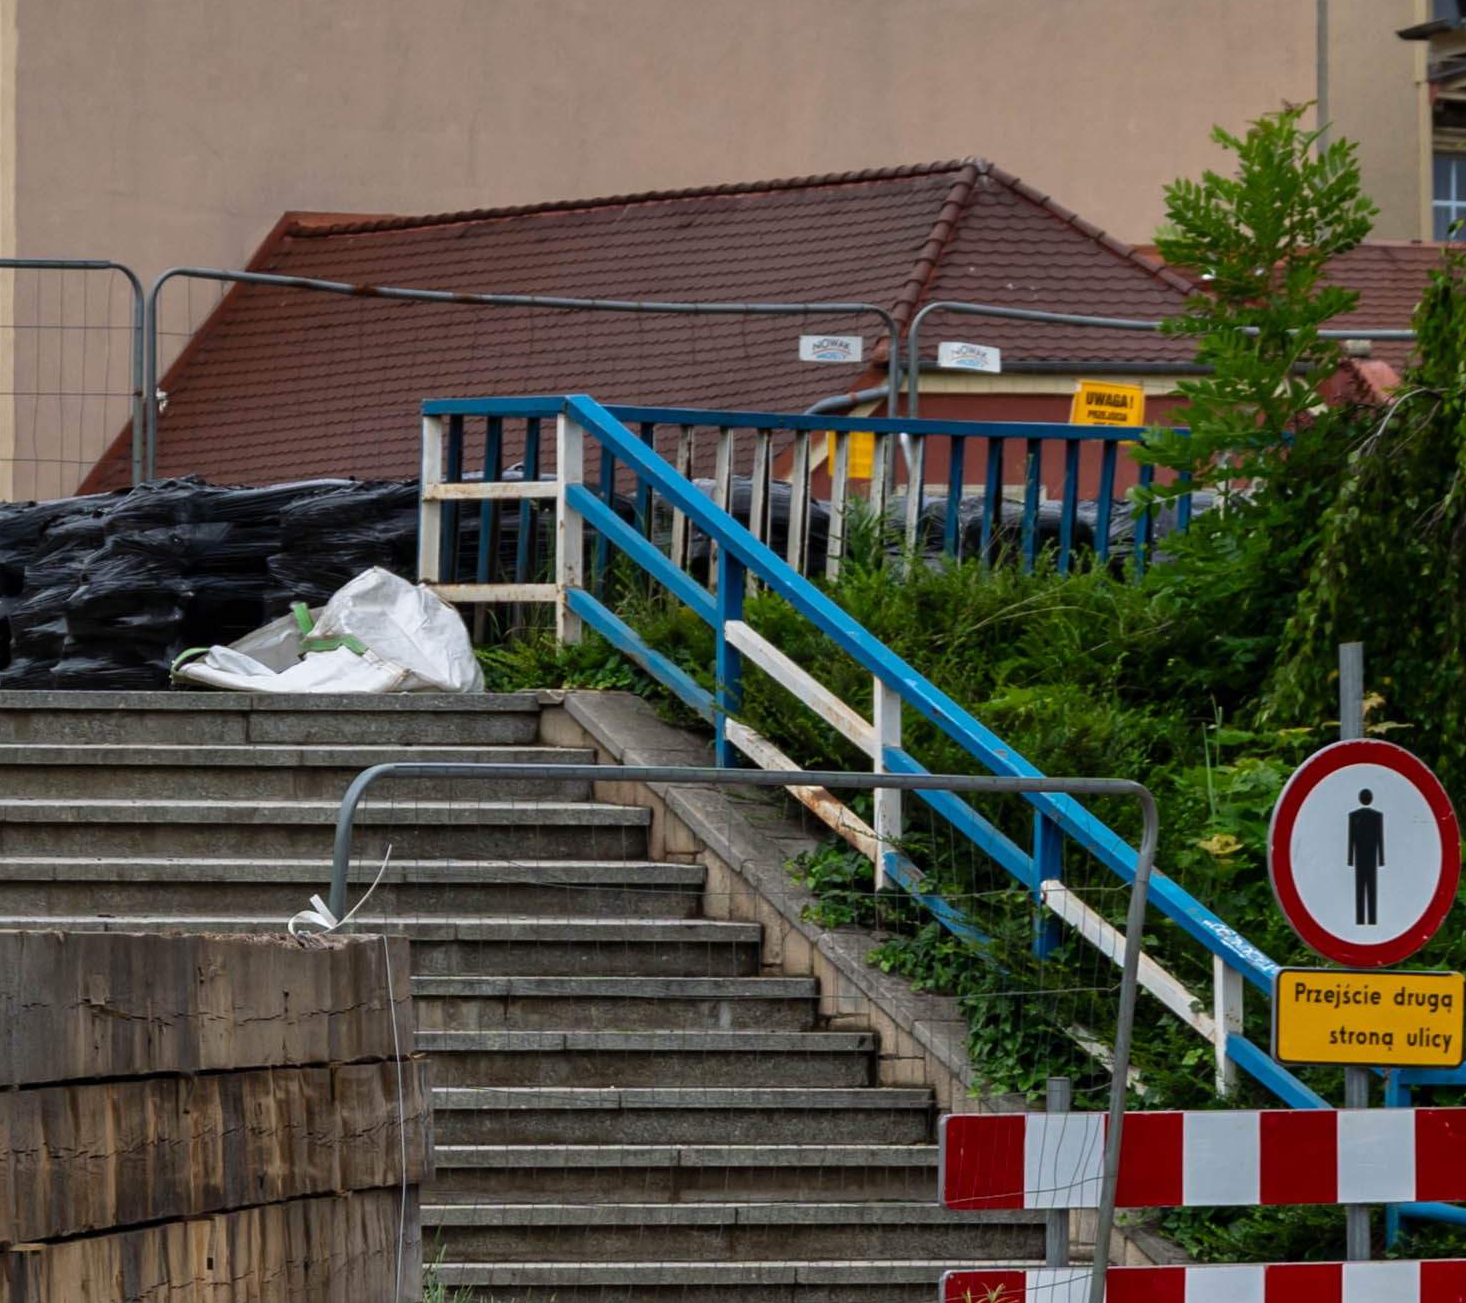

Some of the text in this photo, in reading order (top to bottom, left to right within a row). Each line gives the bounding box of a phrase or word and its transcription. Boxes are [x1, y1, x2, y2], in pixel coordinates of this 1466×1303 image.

[812, 337, 852, 351] NOWAK
[1295, 982, 1453, 1013] Przejście drugą
[1329, 1026, 1452, 1054] stroną ulicy
